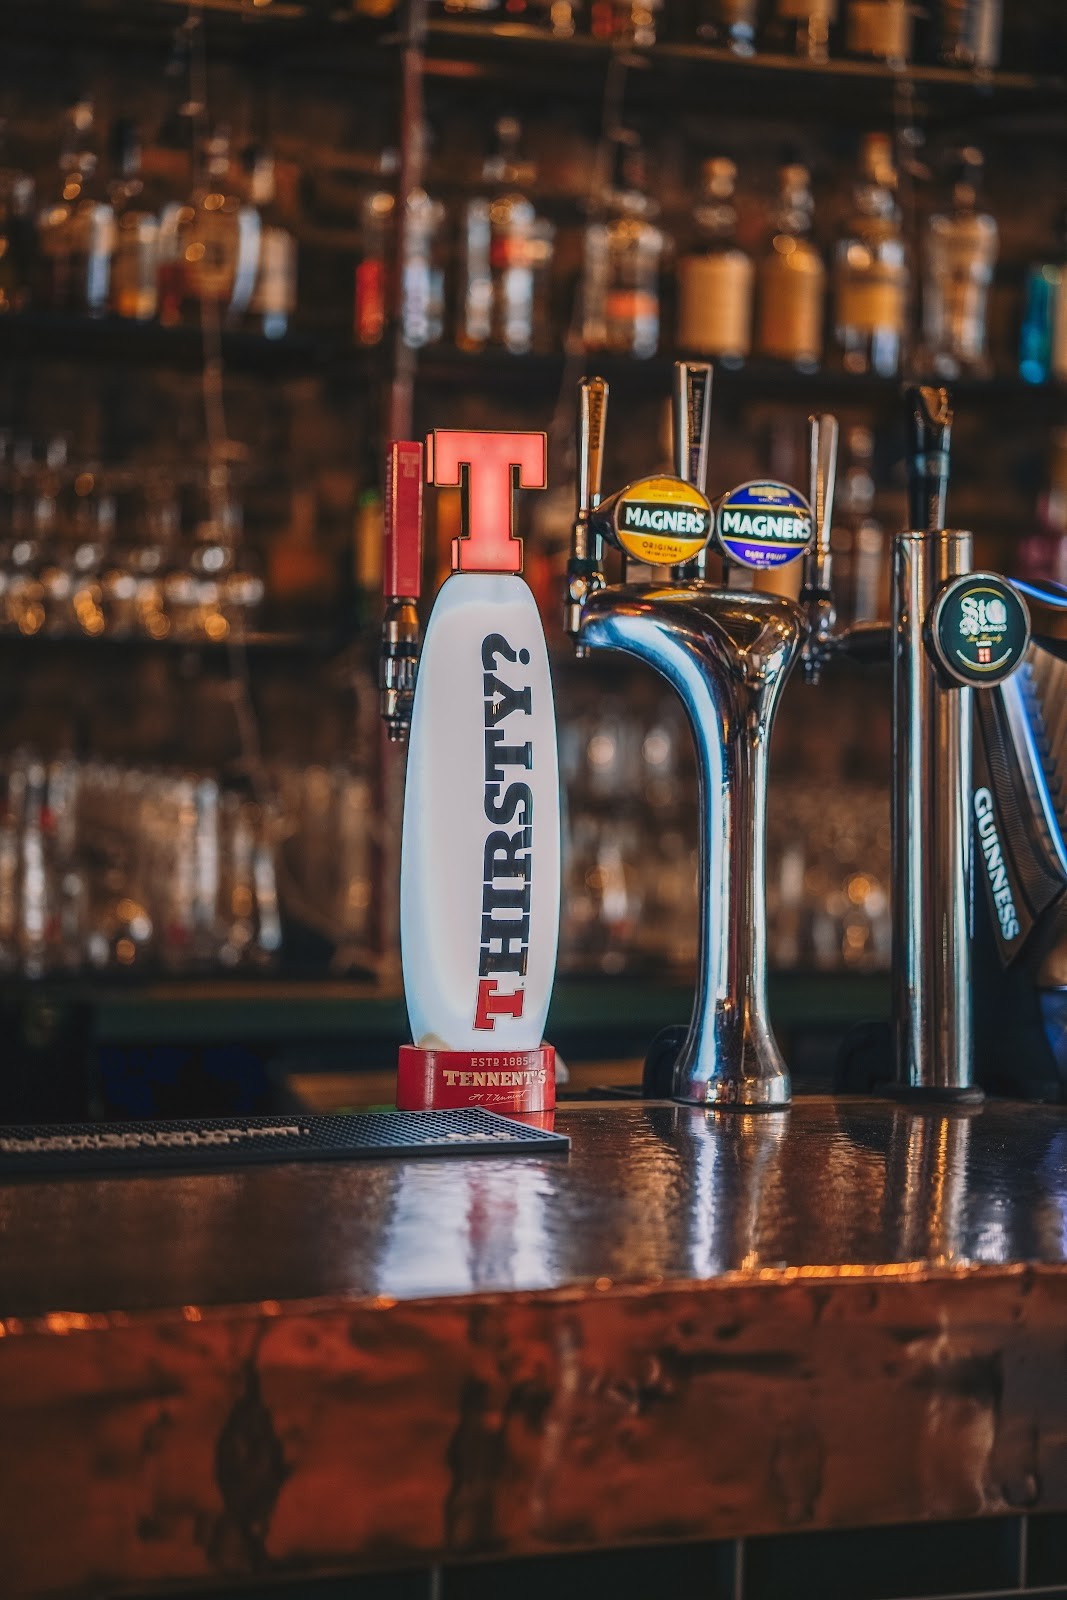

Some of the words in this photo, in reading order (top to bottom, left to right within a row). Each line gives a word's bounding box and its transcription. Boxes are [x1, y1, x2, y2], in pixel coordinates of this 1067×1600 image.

[426, 428, 548, 574] T
[625, 506, 705, 534] MAGNERS
[722, 511, 812, 540] MAGNERS
[641, 541, 682, 553] ORIGINAL
[472, 632, 534, 1031] THIRSTY?
[973, 786, 1021, 941] GUINNESS
[502, 1056, 528, 1066] 1885
[442, 1069, 547, 1087] TENNENT'S
